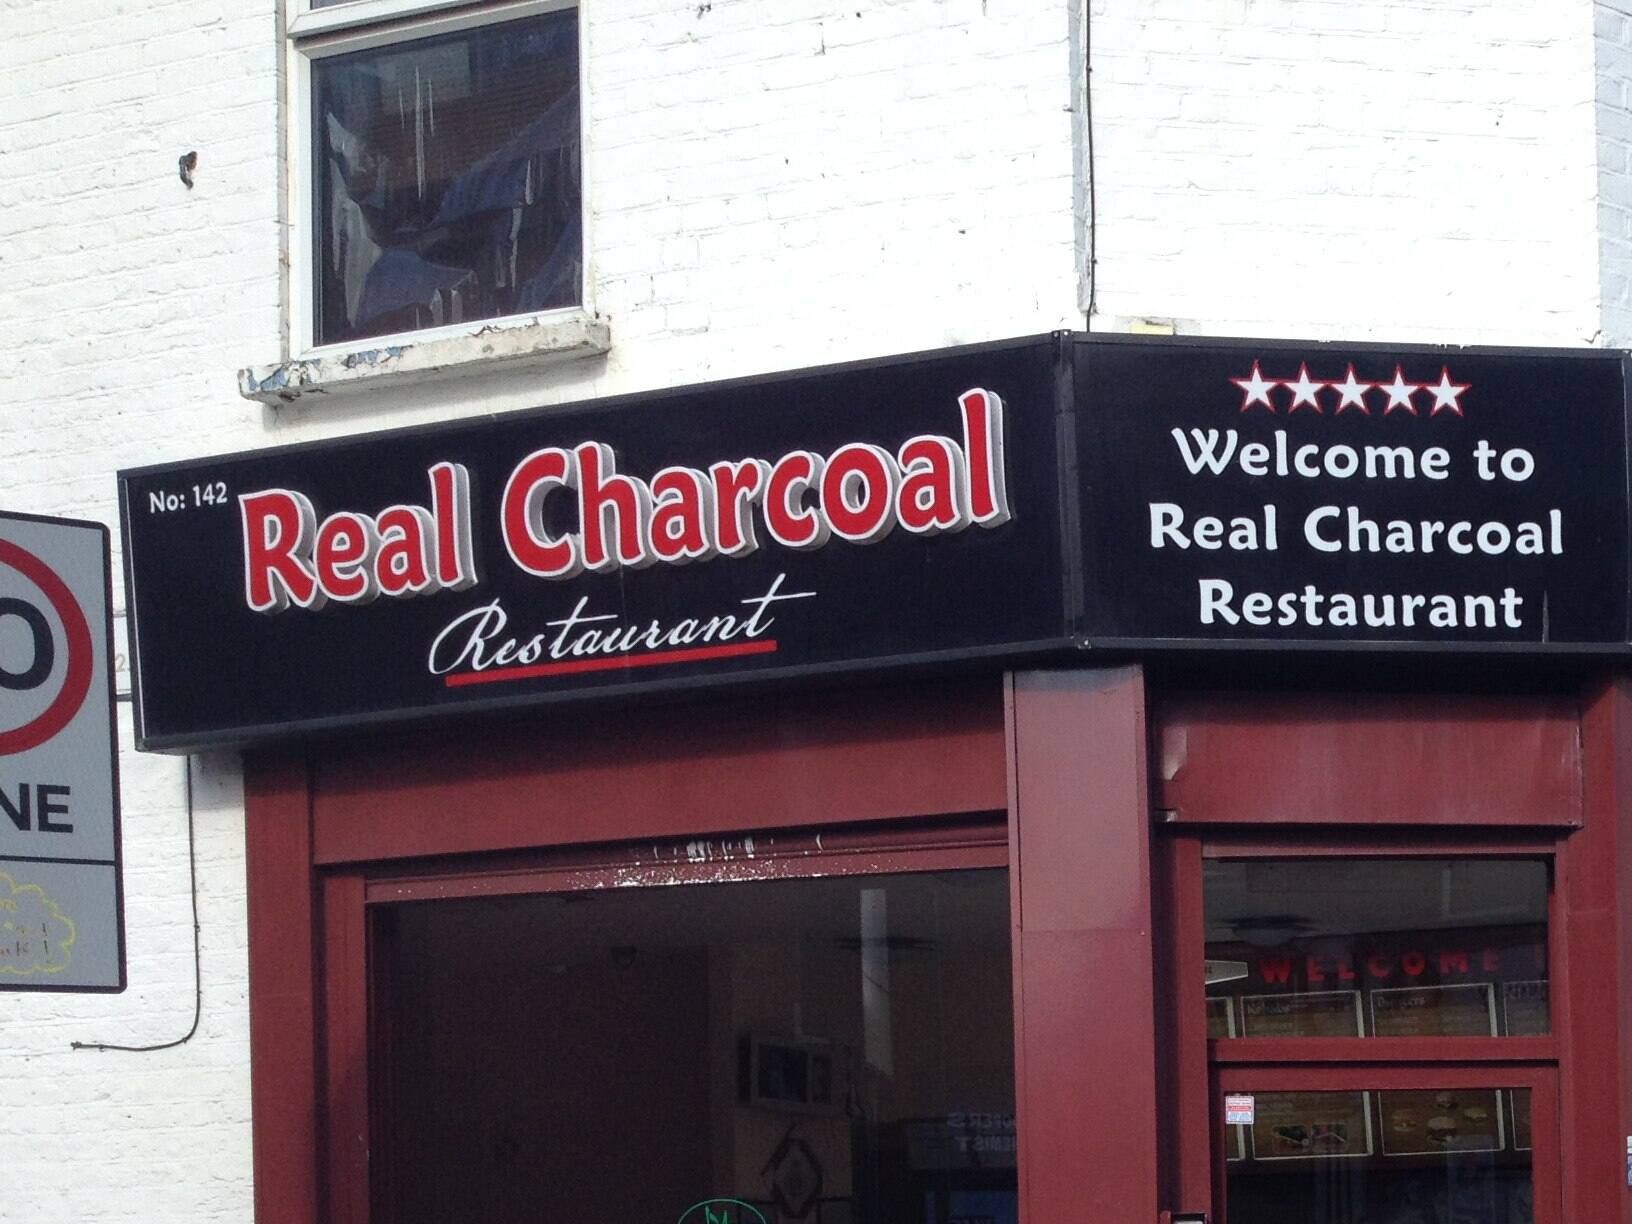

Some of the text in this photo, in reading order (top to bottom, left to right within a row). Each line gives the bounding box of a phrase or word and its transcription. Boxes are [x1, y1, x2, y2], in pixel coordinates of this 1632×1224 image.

[1171, 427, 1535, 482] Welcome to
[149, 481, 228, 514] No: 142
[238, 387, 1013, 615] Real Charcoal
[1149, 502, 1563, 555] Real Charcoal
[428, 573, 817, 677] Restaurant
[1198, 578, 1523, 629] Restaurant
